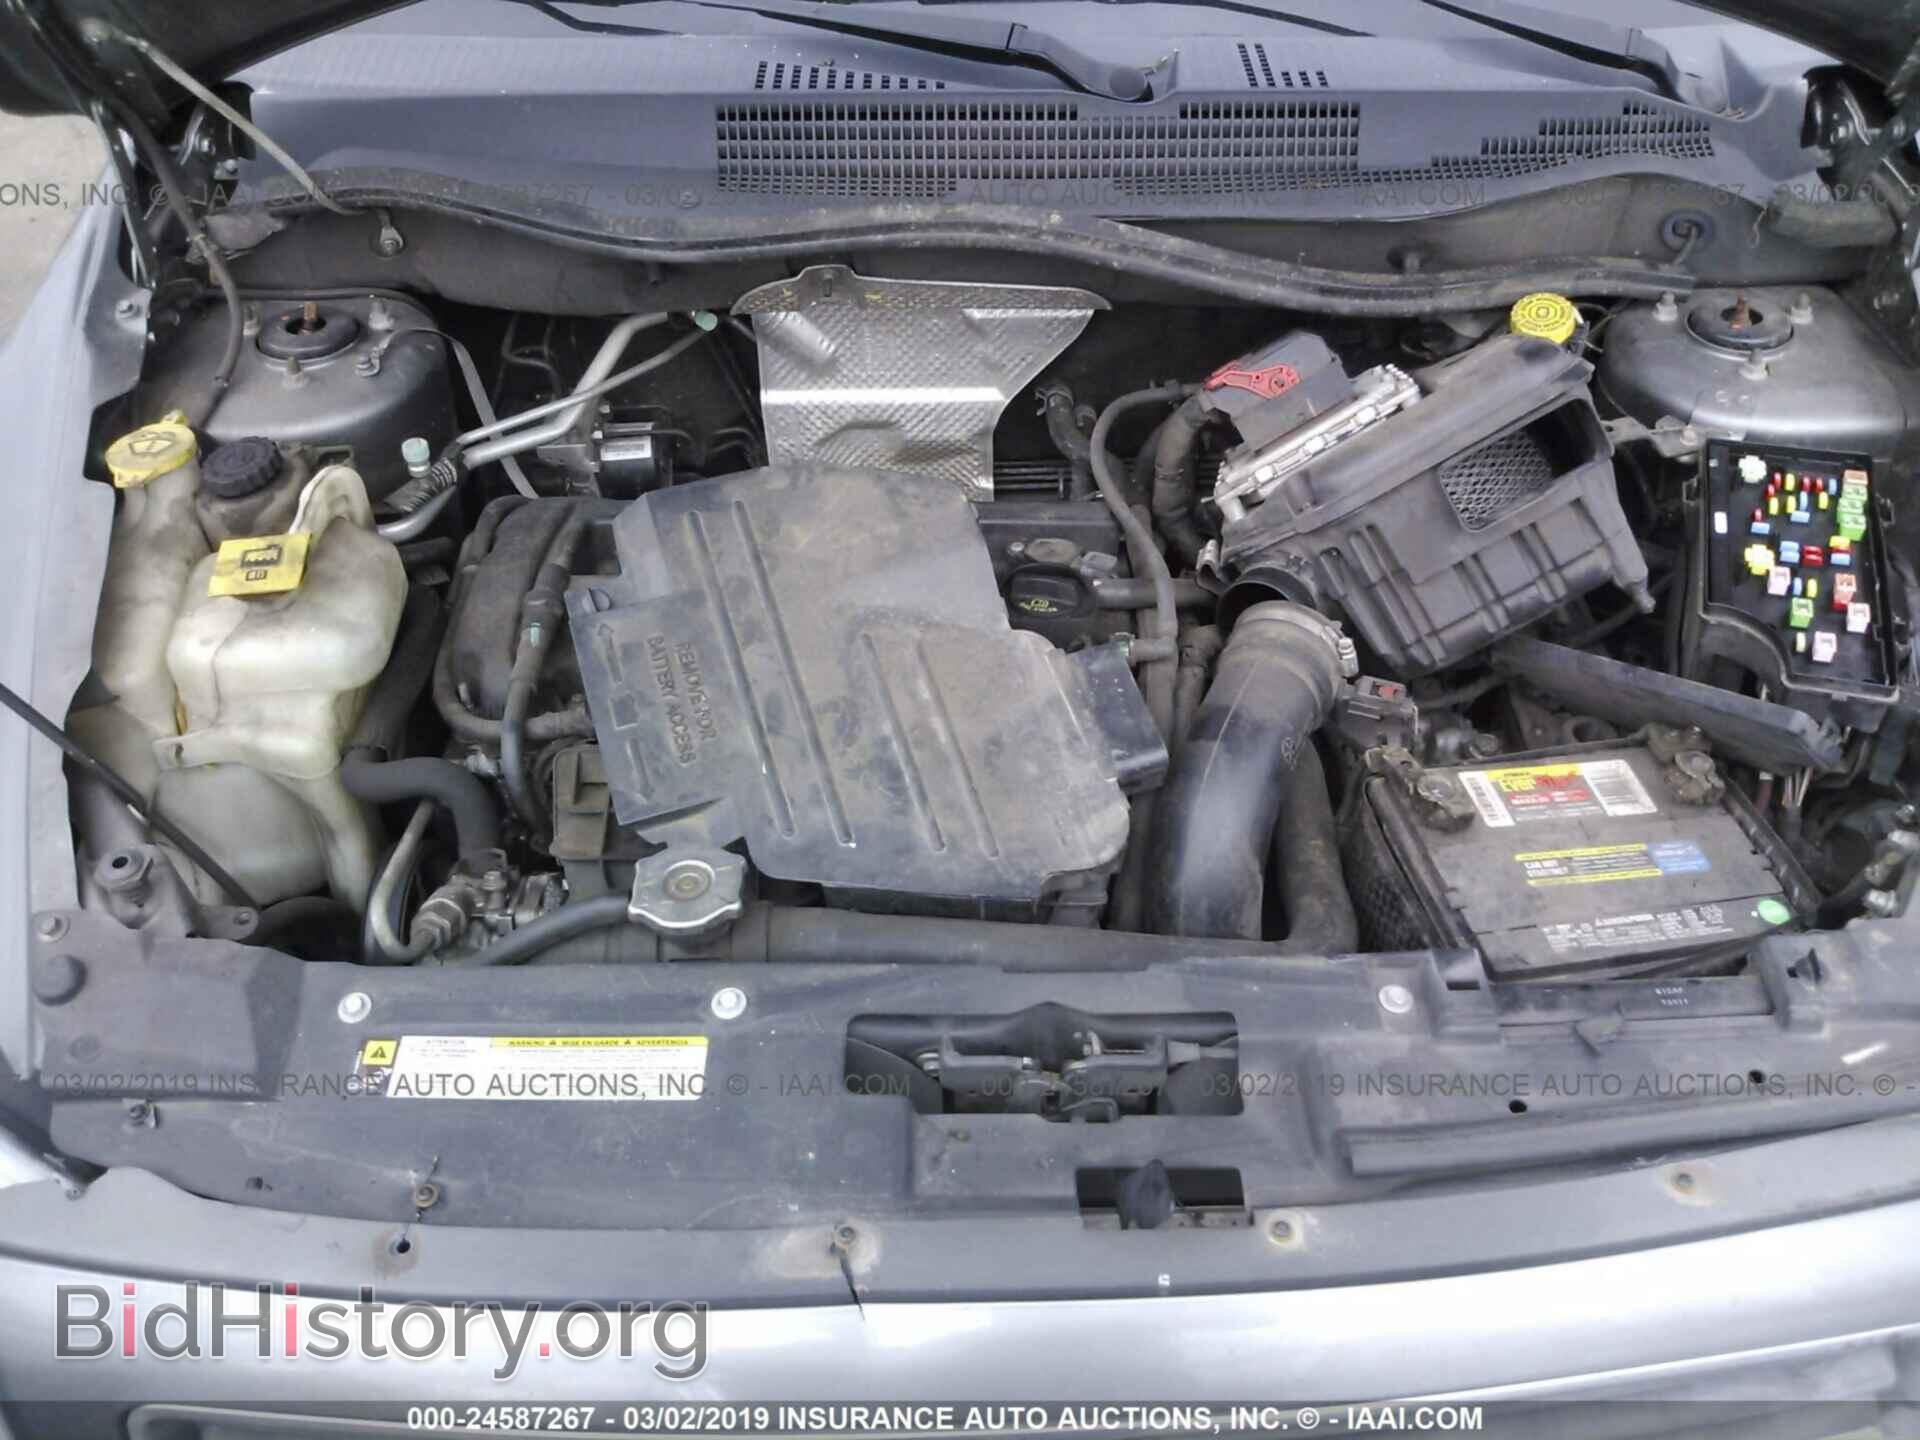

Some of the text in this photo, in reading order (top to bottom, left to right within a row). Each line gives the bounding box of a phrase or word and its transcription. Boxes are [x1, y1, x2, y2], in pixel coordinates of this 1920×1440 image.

[648, 634, 697, 764] BATTERY ACCESS
[675, 641, 717, 741] REMOVE FOR
